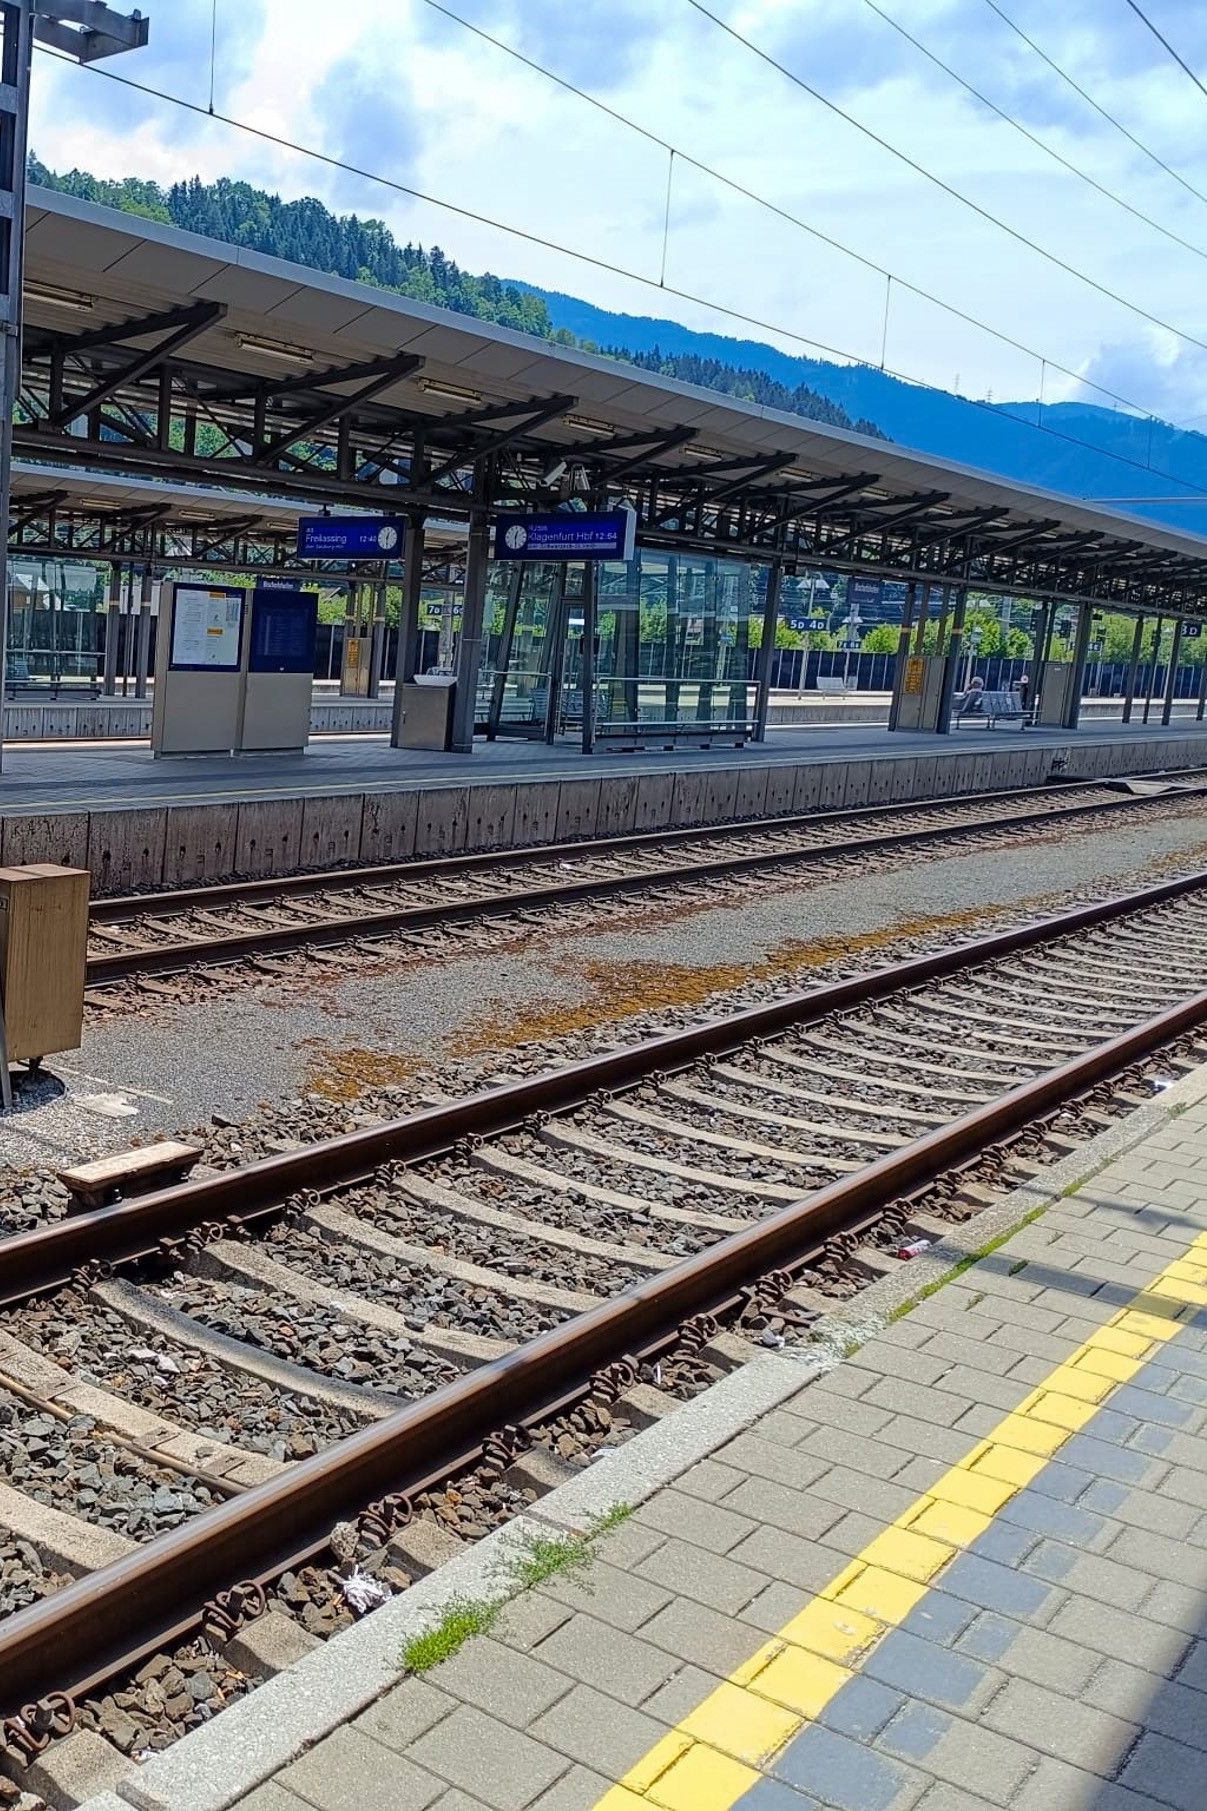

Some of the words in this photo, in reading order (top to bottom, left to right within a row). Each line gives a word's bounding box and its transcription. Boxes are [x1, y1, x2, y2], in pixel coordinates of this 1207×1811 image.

[528, 532, 574, 542] Klagenfurt
[576, 531, 593, 540] Hbf
[790, 619, 805, 629] 5D
[809, 620, 824, 630] 4D
